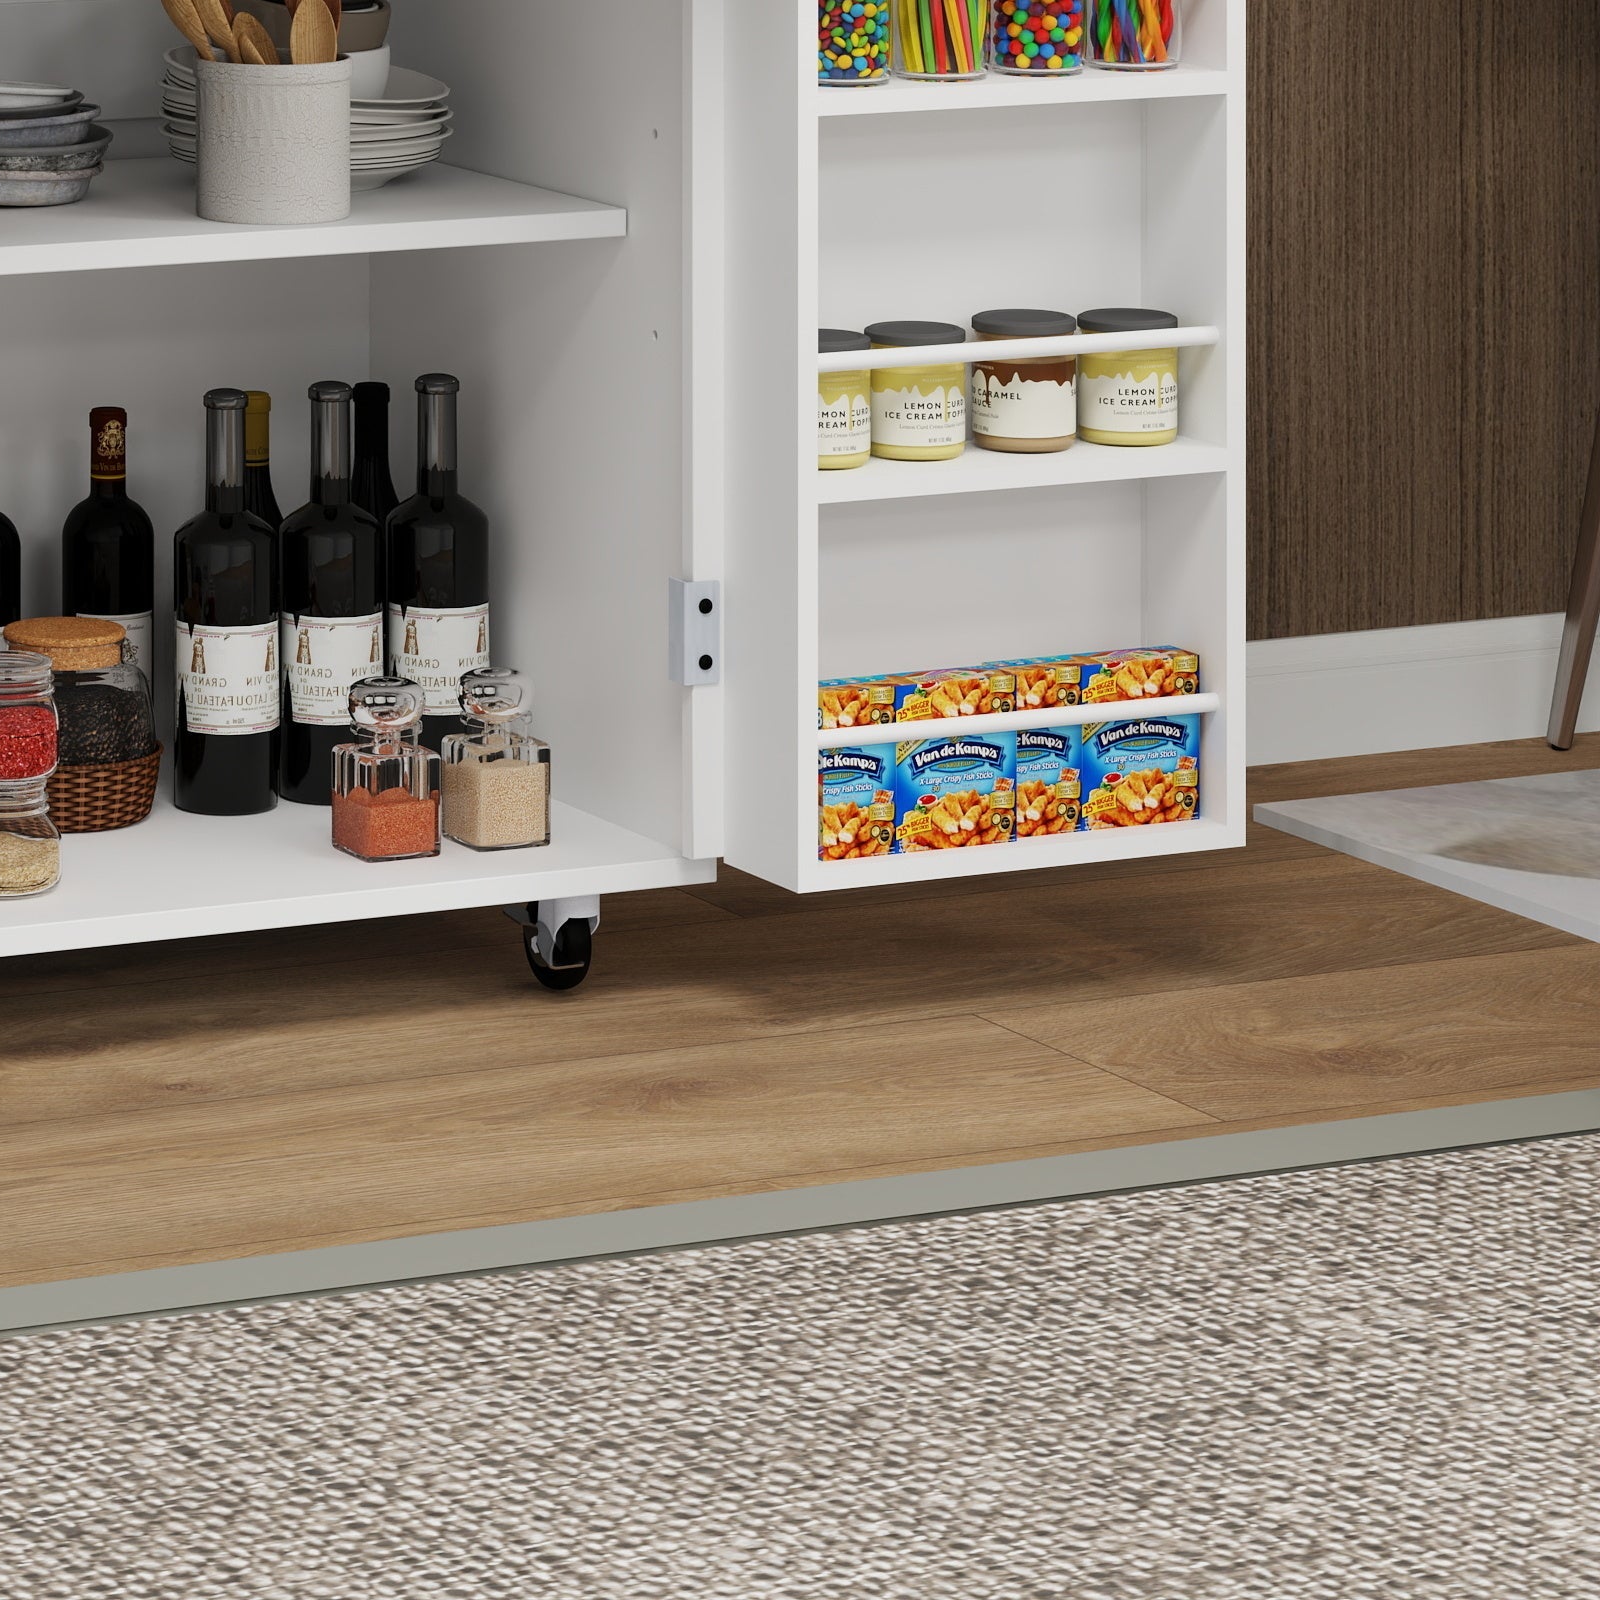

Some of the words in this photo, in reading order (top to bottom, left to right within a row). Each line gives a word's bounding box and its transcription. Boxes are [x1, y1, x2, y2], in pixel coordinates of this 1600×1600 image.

[977, 388, 1022, 400] CARAMEL
[1118, 388, 1155, 396] LEMON
[904, 402, 942, 410] LEMON
[972, 398, 991, 408] AUCE
[1099, 397, 1115, 405] ICE
[1120, 398, 1156, 406] CREAM
[818, 410, 846, 418] MON
[885, 411, 900, 419] ICE
[906, 412, 942, 420] CREAM
[818, 421, 847, 429] REAM
[1096, 679, 1115, 692] BIGGER
[910, 700, 930, 713] BIGGER
[1100, 729, 1126, 746] Van
[1125, 723, 1140, 736] de
[1139, 721, 1181, 738] Kamp's
[1021, 732, 1063, 749] Kamp's
[914, 750, 940, 767] Van
[940, 744, 956, 757] de
[955, 741, 998, 759] Kamp's
[1104, 756, 1127, 764] X-Large
[1128, 754, 1146, 762] Crispy
[1160, 750, 1177, 758] Sticks
[833, 754, 877, 771] Kamp's
[1016, 766, 1028, 774] ispy
[1029, 763, 1041, 771] Fish
[1042, 762, 1059, 770] Sticks
[919, 777, 942, 786] X-Large
[943, 775, 962, 784] Crispy
[823, 786, 841, 796] Crispy
[841, 785, 854, 793] Fish
[855, 783, 873, 792] Sticks
[1096, 794, 1115, 806] BIGGER
[910, 816, 930, 828] BIGGER
